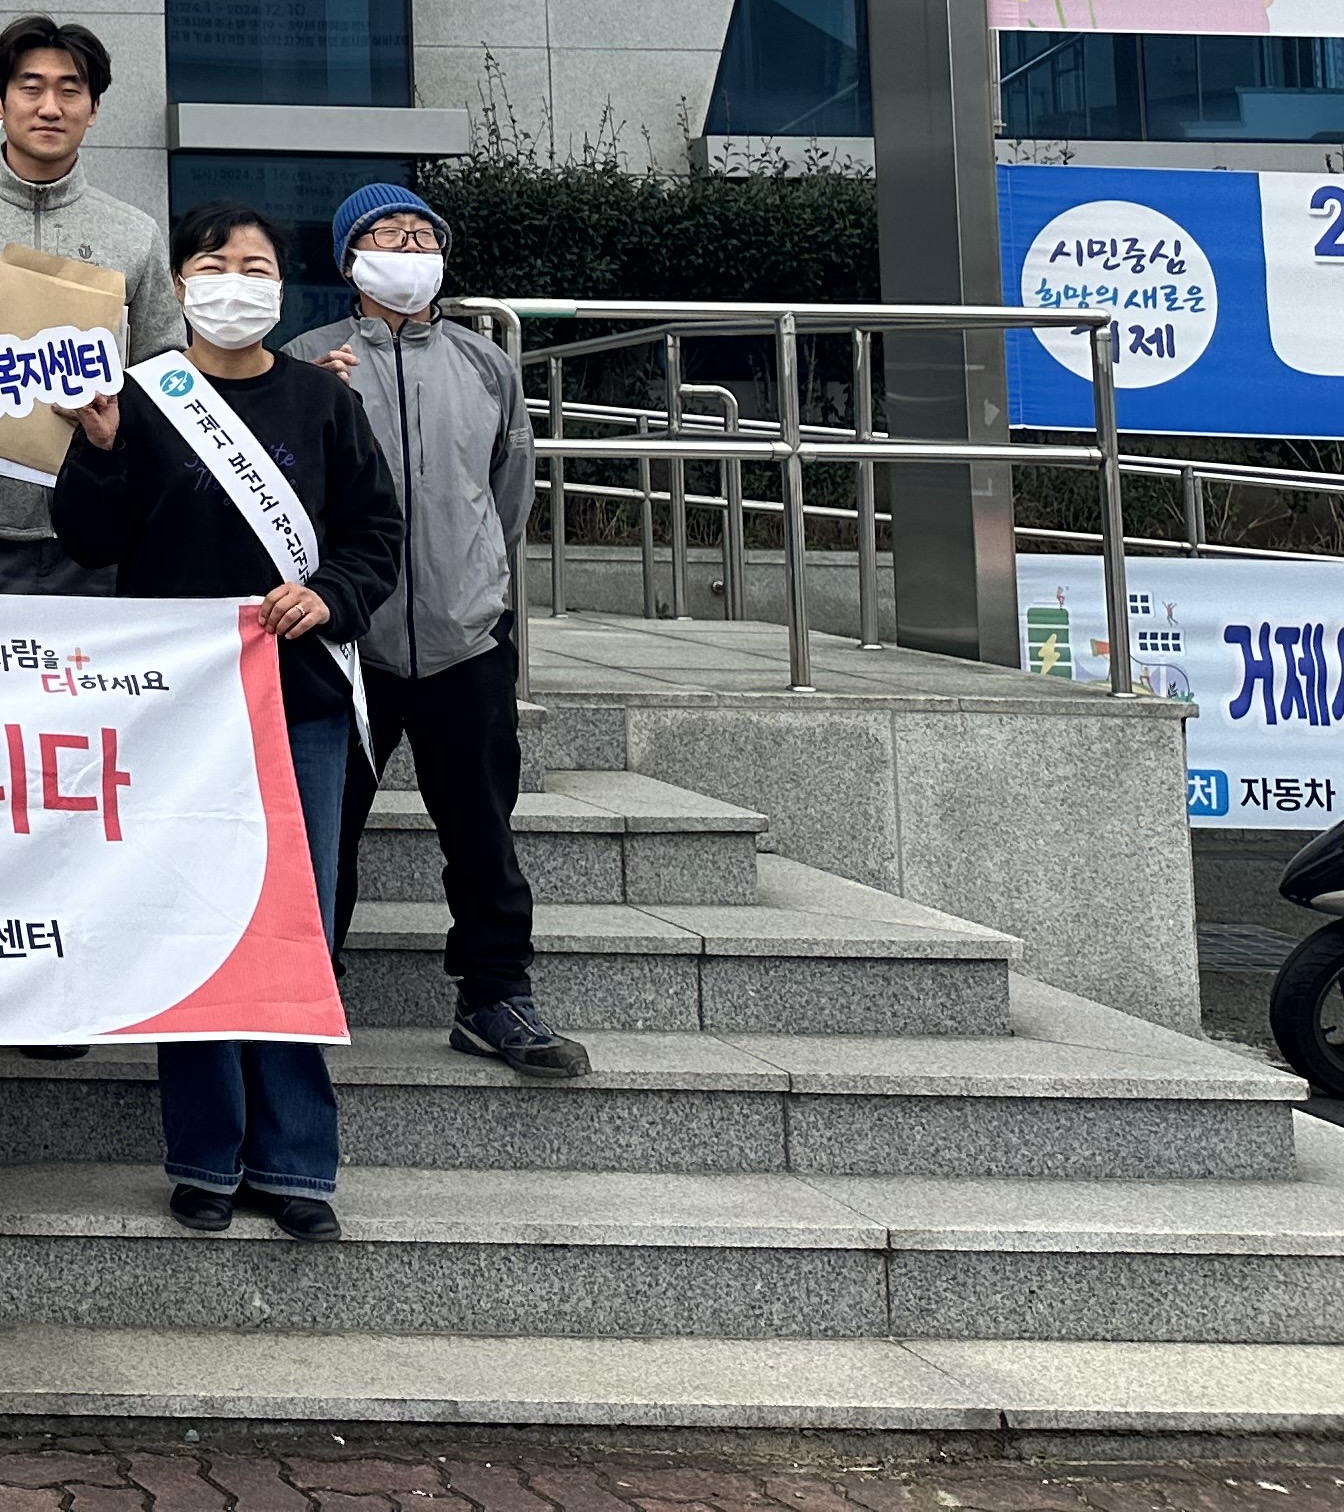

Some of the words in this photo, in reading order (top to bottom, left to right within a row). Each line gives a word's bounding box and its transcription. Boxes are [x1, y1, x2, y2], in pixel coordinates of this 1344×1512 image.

[1049, 237, 1187, 275] 시민중심
[1035, 278, 1118, 309] 희망의
[1123, 285, 1207, 314] 새로운
[184, 397, 235, 451] 거제시
[227, 451, 280, 513] 보건소
[40, 667, 170, 697] 더하세요
[1223, 621, 1344, 727] 거제
[1240, 777, 1336, 812] 자동차
